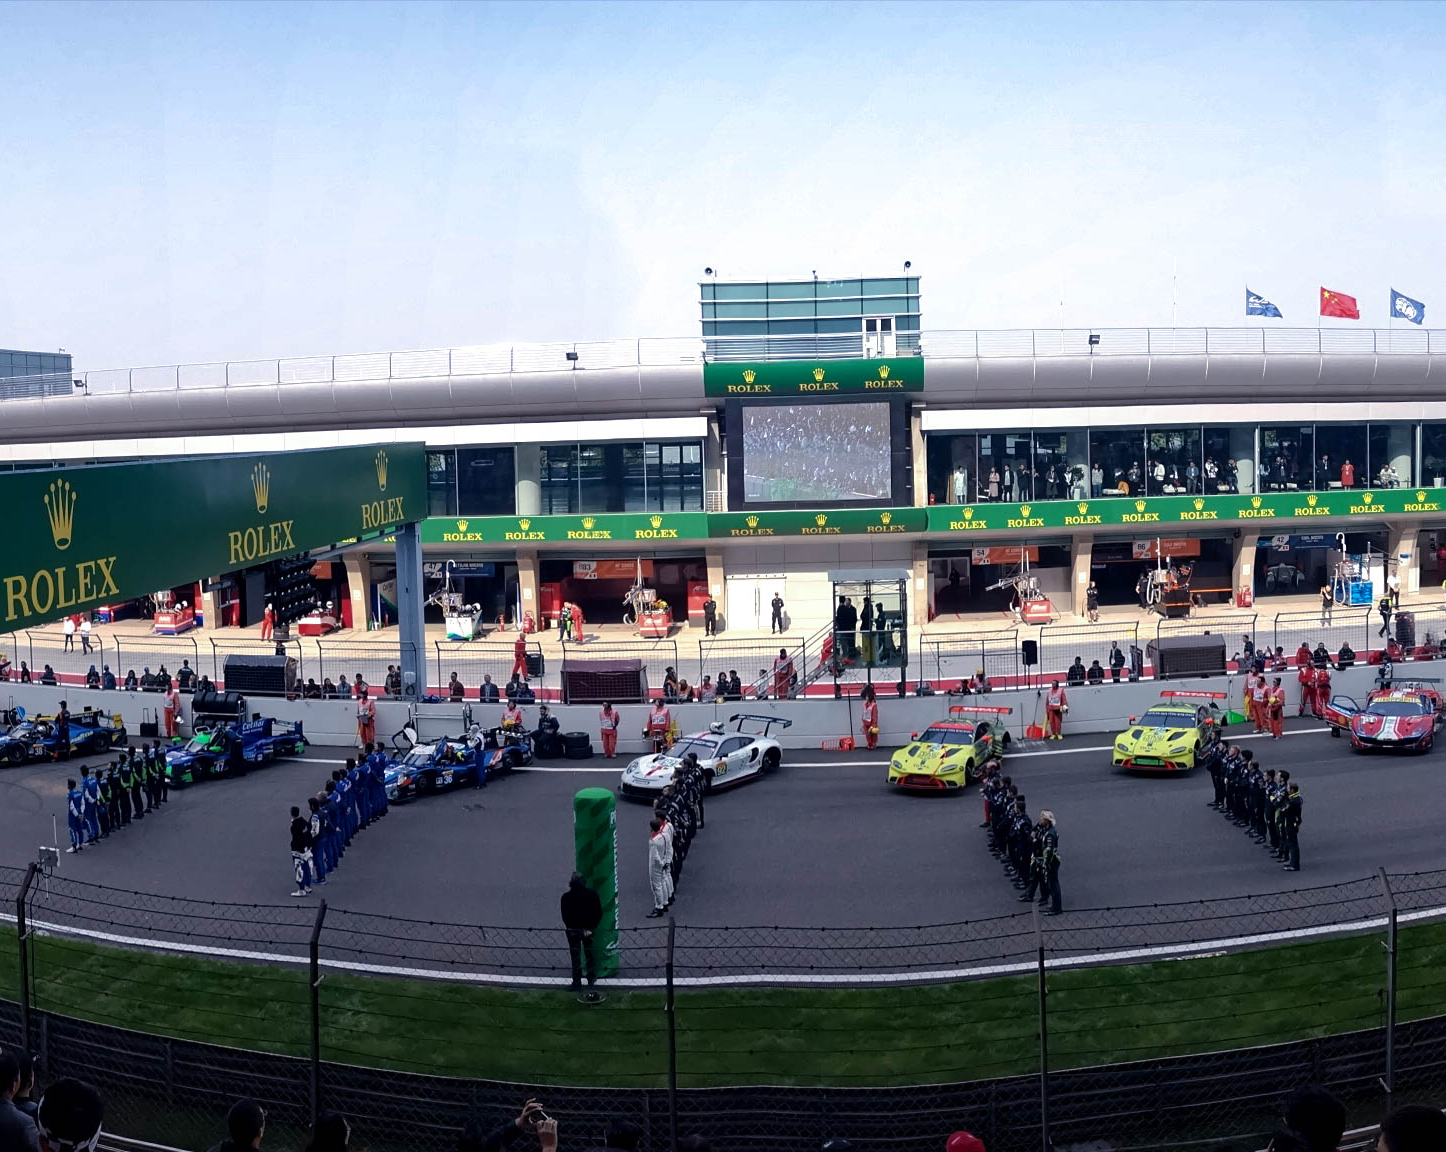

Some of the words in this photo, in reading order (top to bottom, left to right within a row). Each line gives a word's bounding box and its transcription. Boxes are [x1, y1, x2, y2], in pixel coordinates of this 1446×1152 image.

[728, 384, 771, 393] ROLEX
[799, 382, 839, 392] ROLEX
[864, 379, 904, 389] ROLEX
[1296, 508, 1331, 516] ROLEX
[1351, 505, 1385, 513] ROLEX
[1405, 504, 1438, 512] ROLEX
[362, 497, 404, 530] ROLEX
[1123, 513, 1159, 522] ROLEX
[1181, 512, 1217, 520] ROLEX
[1239, 510, 1275, 518] ROLEX
[951, 520, 986, 529] ROLEX
[1008, 519, 1044, 528] ROLEX
[1065, 516, 1101, 525] ROLEX
[567, 529, 612, 539] ROLEX
[635, 528, 678, 539] ROLEX
[731, 528, 775, 537] ROLEX
[801, 526, 842, 535] ROLEX
[867, 525, 907, 534] ROLEX
[443, 532, 484, 542] ROLEX
[505, 531, 546, 541] ROLEX
[228, 520, 294, 565] ROLEX
[4, 557, 120, 622] ROLEX
[216, 763, 224, 772] 47
[716, 765, 726, 775] 92
[444, 776, 452, 784] 36
